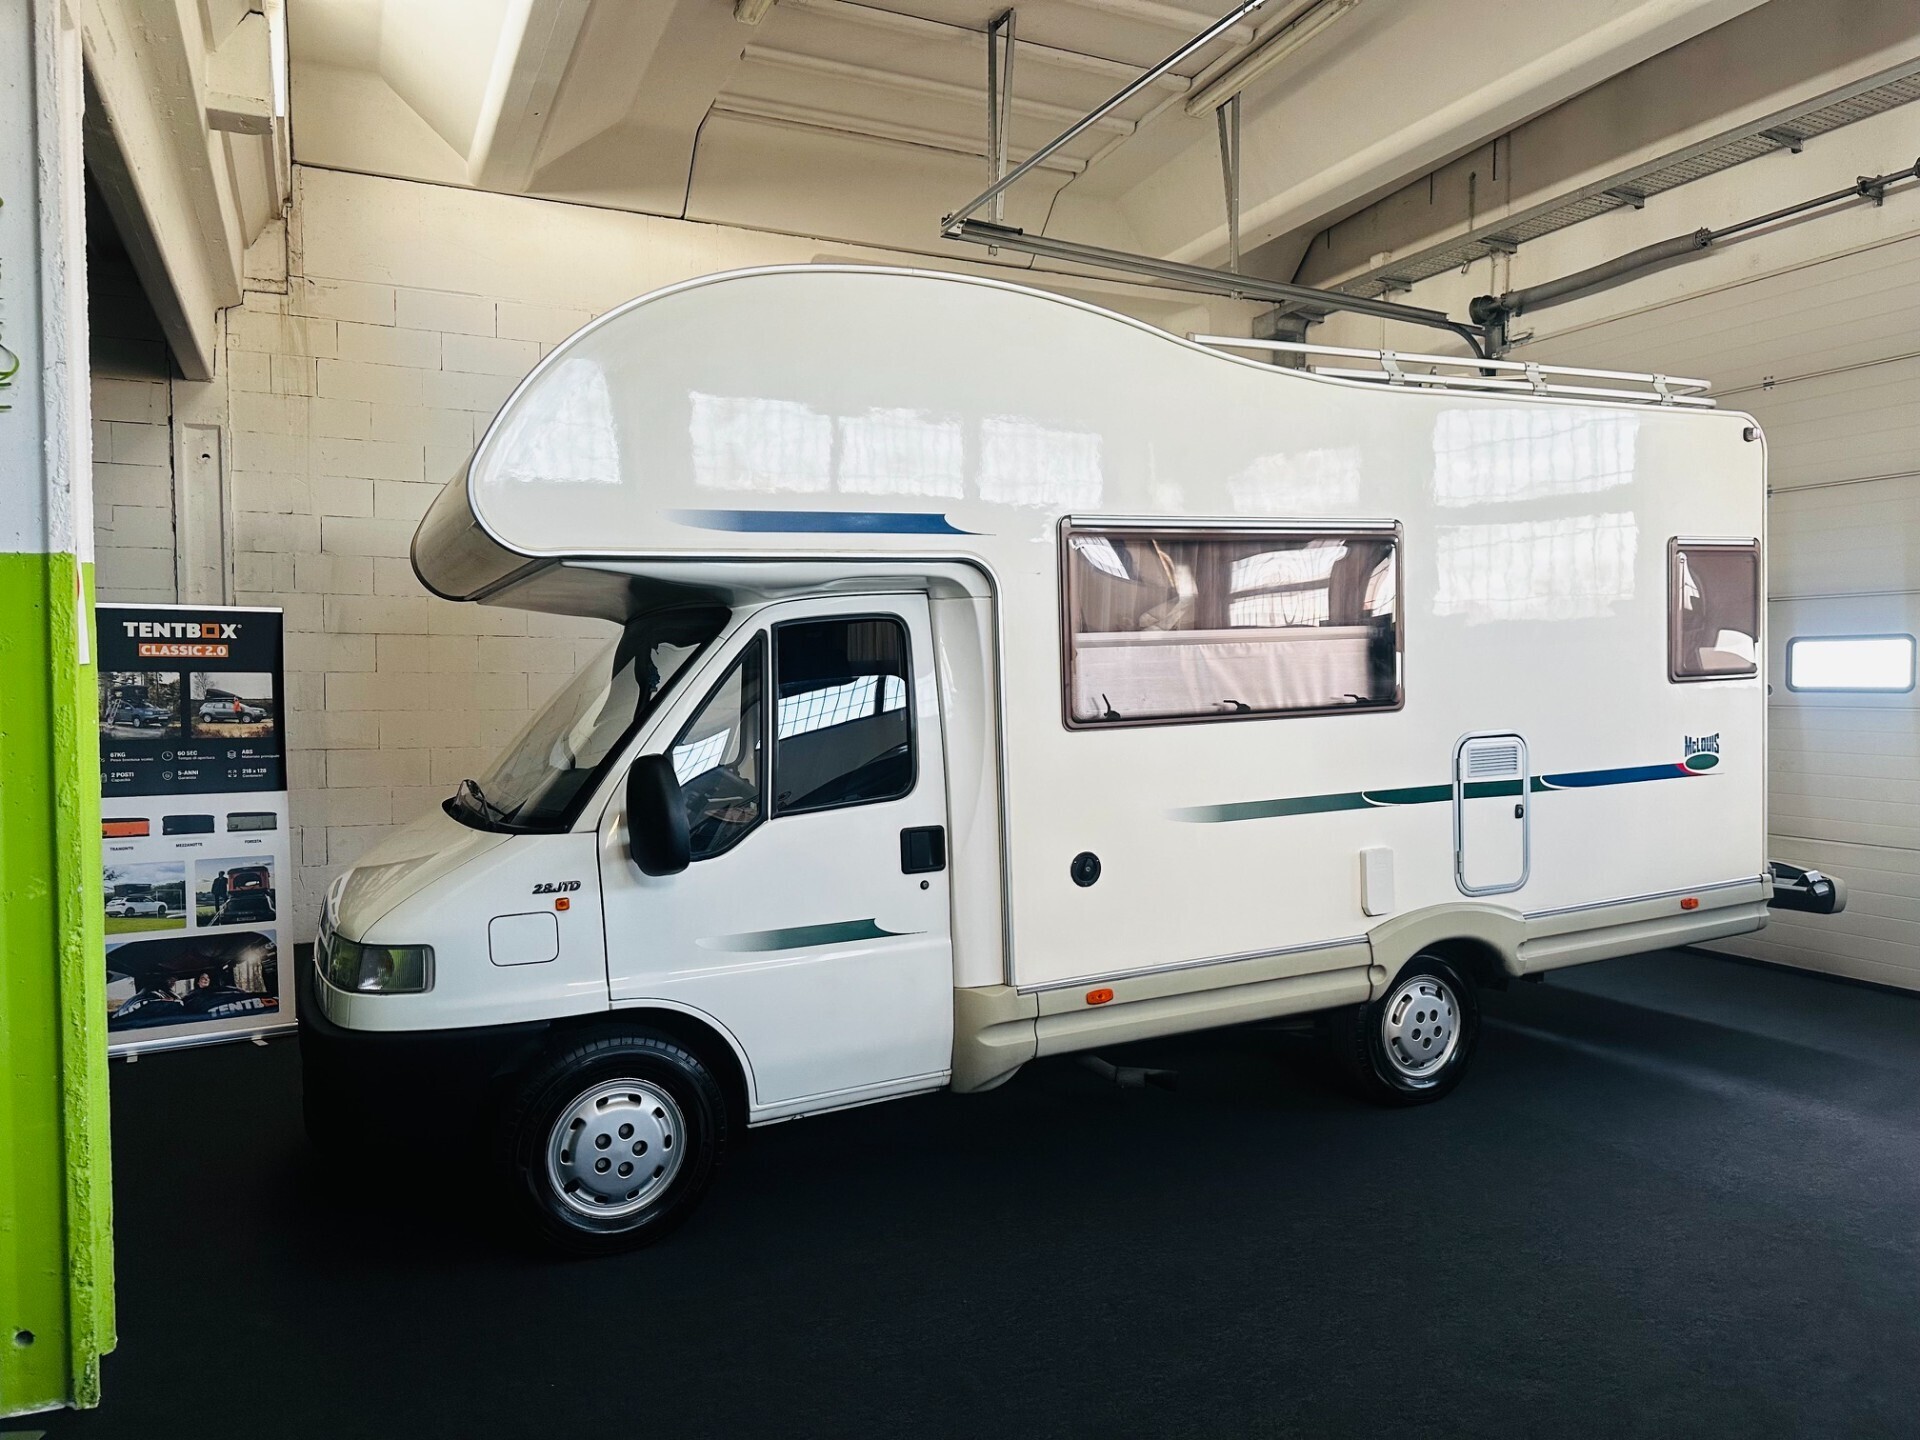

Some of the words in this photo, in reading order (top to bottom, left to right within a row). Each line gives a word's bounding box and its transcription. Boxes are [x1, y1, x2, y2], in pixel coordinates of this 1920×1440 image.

[123, 621, 238, 639] TENTBOX
[141, 645, 202, 656] CLASSIC
[204, 645, 227, 656] 2.0
[1684, 733, 1719, 757] McLOUIS
[207, 996, 279, 1018] TENTBO
